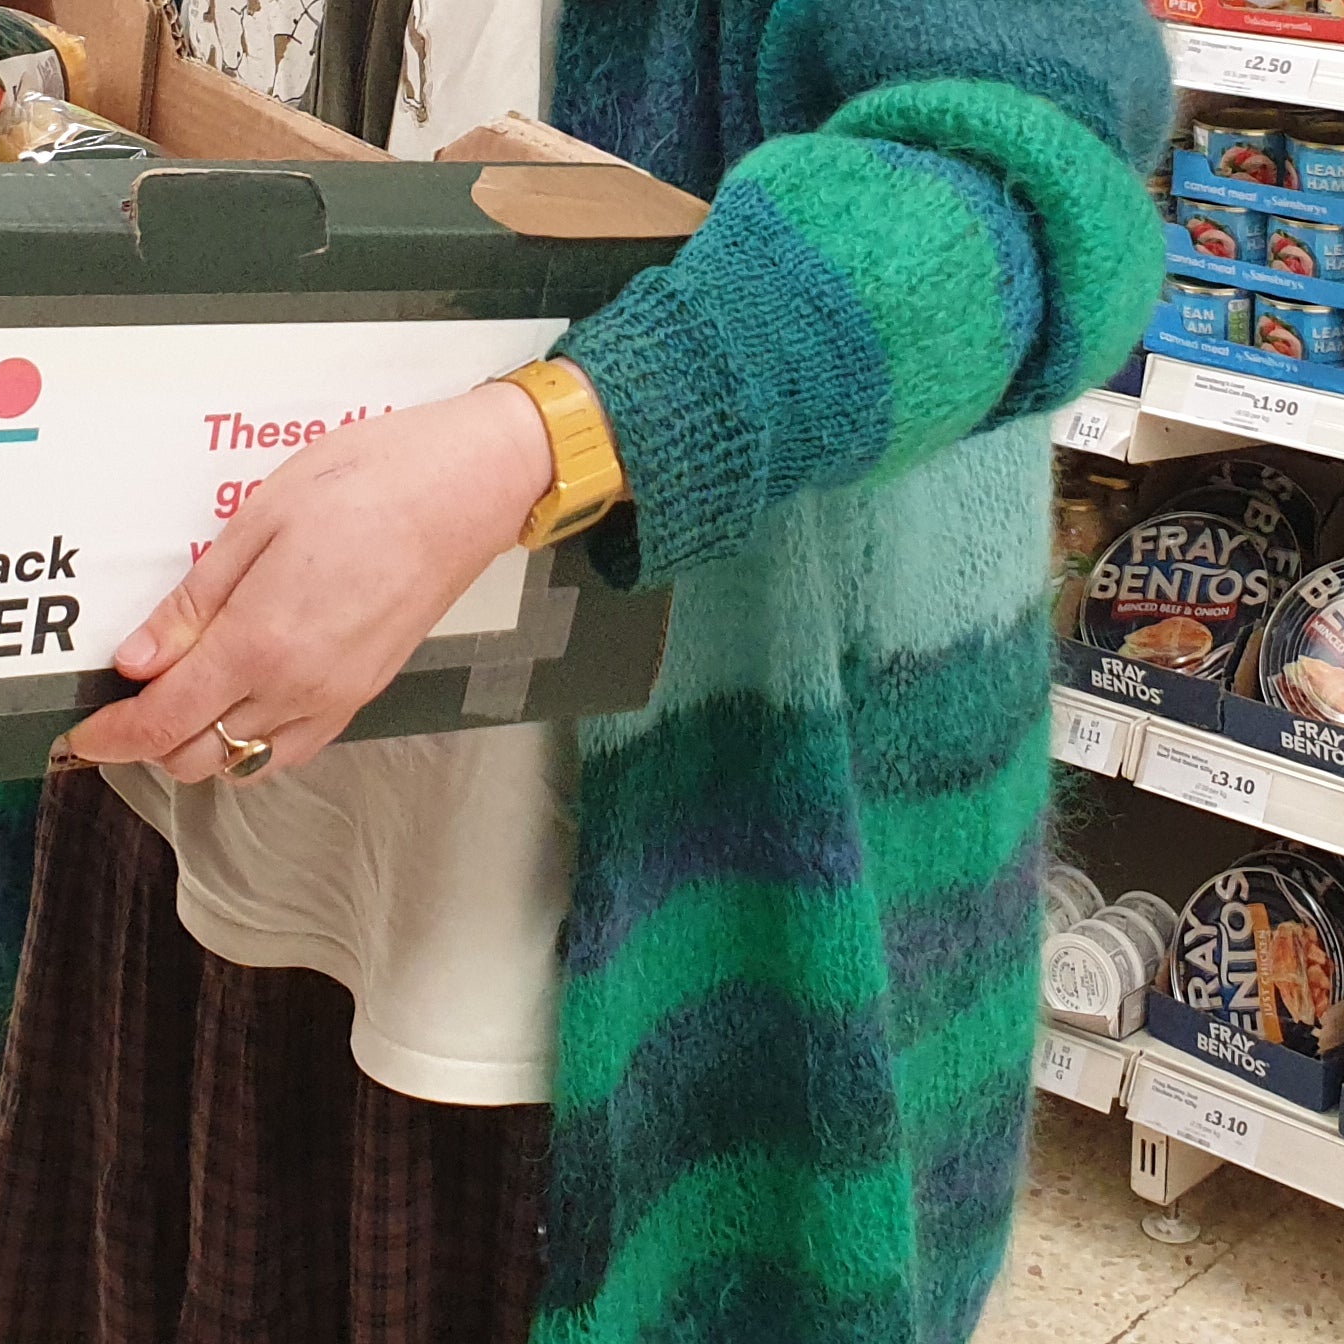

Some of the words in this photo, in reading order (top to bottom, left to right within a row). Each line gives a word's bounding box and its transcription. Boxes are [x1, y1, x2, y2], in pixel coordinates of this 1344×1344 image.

[1244, 55, 1292, 76] £2.50
[1253, 396, 1298, 416] £1.90
[204, 413, 328, 451] These
[1130, 524, 1248, 565] FRAY
[1117, 601, 1154, 616] MINCED
[1156, 604, 1181, 616] BEEF
[1193, 605, 1231, 620] ONION
[1080, 728, 1101, 744] L11
[1211, 771, 1255, 795] £3.10
[1257, 930, 1274, 984] CHICKEN
[1258, 989, 1276, 1017] JUST
[1052, 1053, 1072, 1070] L11
[1205, 1110, 1247, 1136] £3.10
